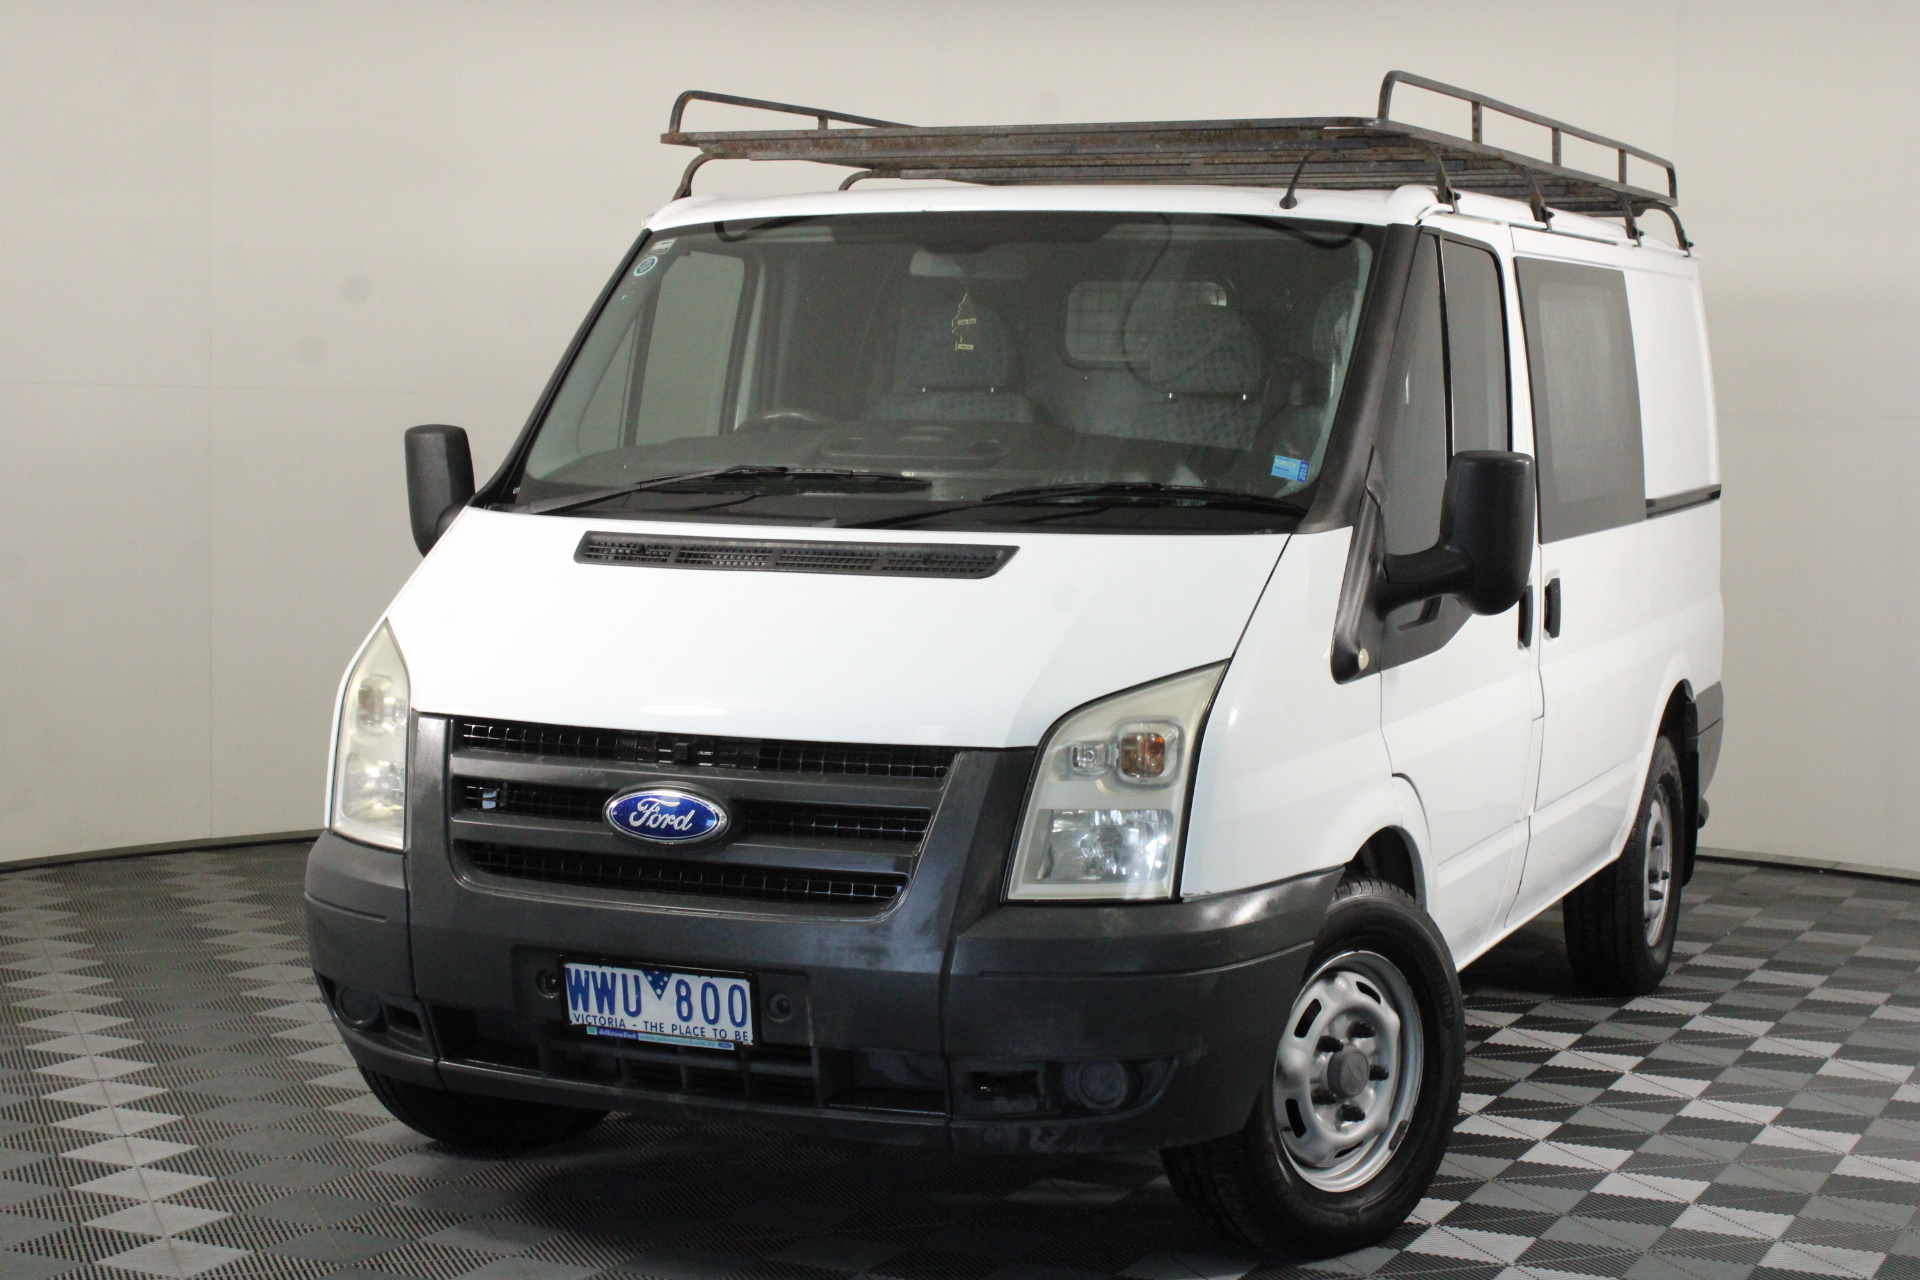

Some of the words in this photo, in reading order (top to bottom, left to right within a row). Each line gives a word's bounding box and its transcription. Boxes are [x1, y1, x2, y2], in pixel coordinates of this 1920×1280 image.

[1299, 463, 1308, 481] 2019
[629, 797, 696, 831] Ford
[565, 967, 642, 1018] WWU
[675, 978, 748, 1028] 800
[573, 1012, 626, 1029] VICTORIA
[643, 1020, 665, 1033] THE
[671, 1023, 706, 1038] PLACE
[712, 1028, 728, 1040] TO
[734, 1030, 749, 1042] BE
